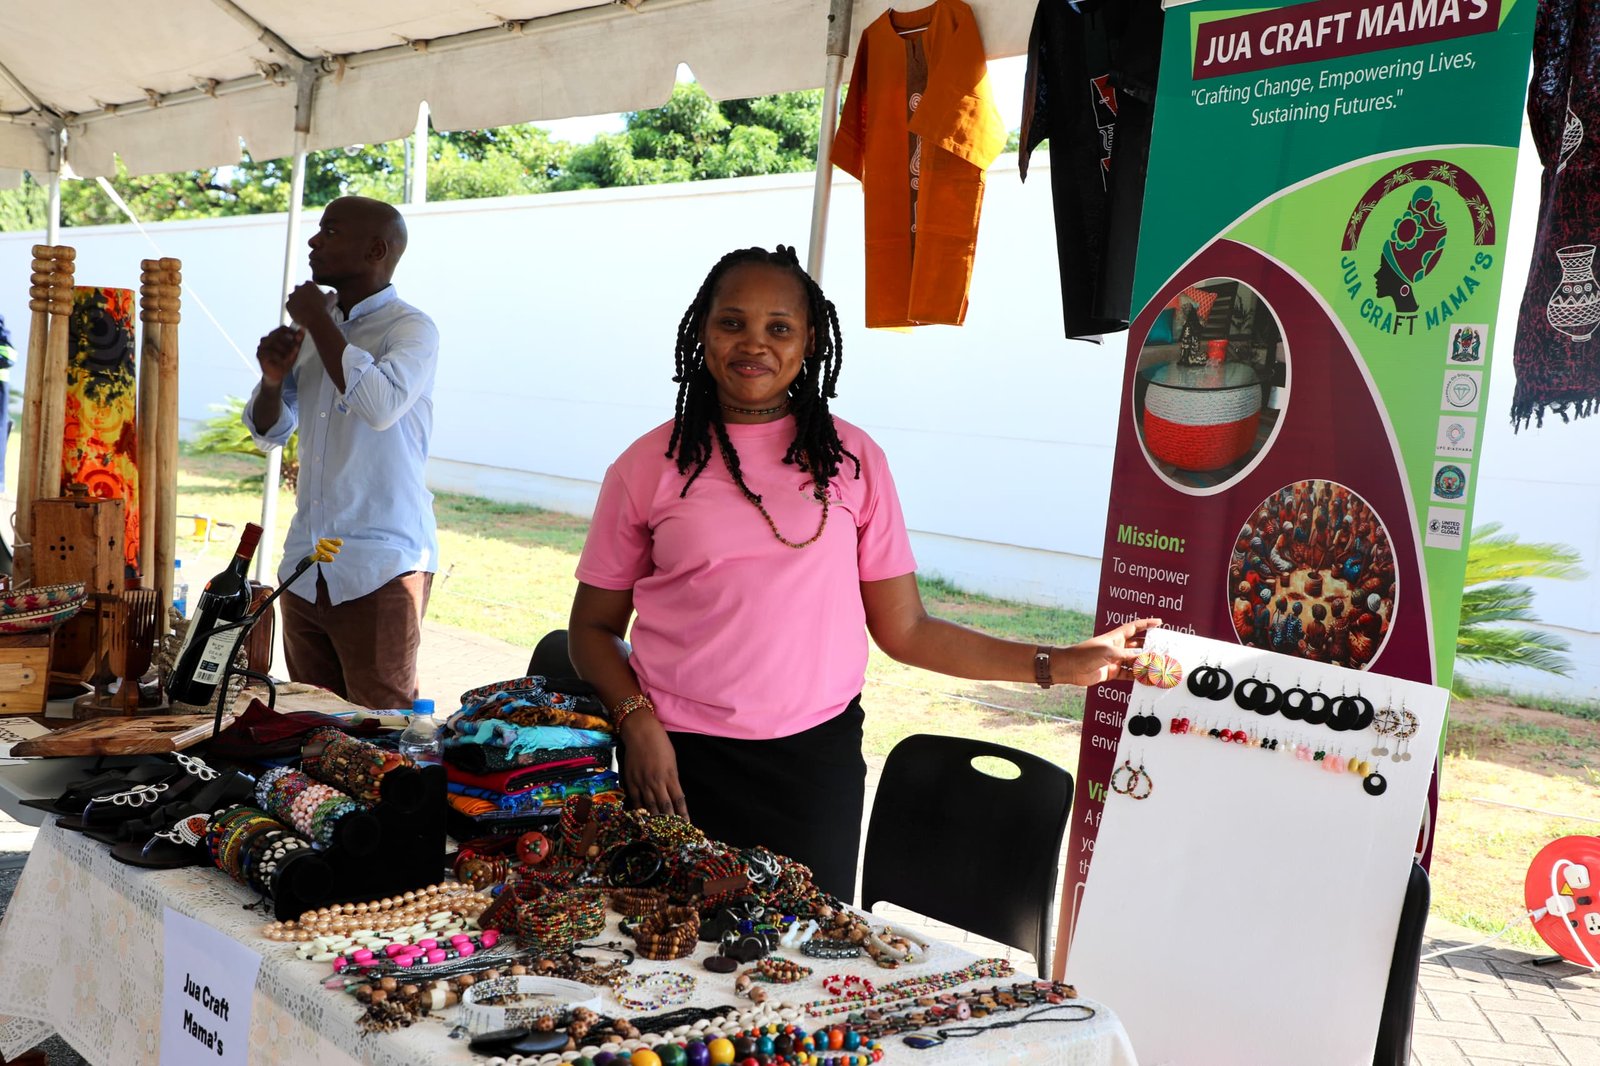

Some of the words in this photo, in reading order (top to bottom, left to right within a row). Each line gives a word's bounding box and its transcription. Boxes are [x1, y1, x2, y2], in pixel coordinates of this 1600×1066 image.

[1202, 30, 1252, 67] JUA
[1259, 11, 1352, 57] CRAFT
[1356, 0, 1489, 41] MAMAS
[1190, 84, 1251, 107] "Crafting
[1254, 76, 1315, 99] Change,
[1319, 58, 1424, 92] Empowering
[1428, 51, 1477, 74] Lives,
[1250, 100, 1330, 127] Sustaining
[1333, 88, 1404, 118] Futures."
[1340, 255, 1363, 301] JUA
[1359, 297, 1419, 336] CRAFT
[1424, 251, 1494, 331] MAMA'S
[1116, 523, 1186, 554] Mission:
[1112, 556, 1127, 574] To
[1128, 562, 1190, 586] empower
[1109, 585, 1155, 606] women
[1157, 594, 1184, 612] and
[1084, 809, 1093, 826] A
[183, 972, 201, 1002] Jua
[202, 985, 230, 1023] Craft
[182, 1008, 224, 1057] Mama's
